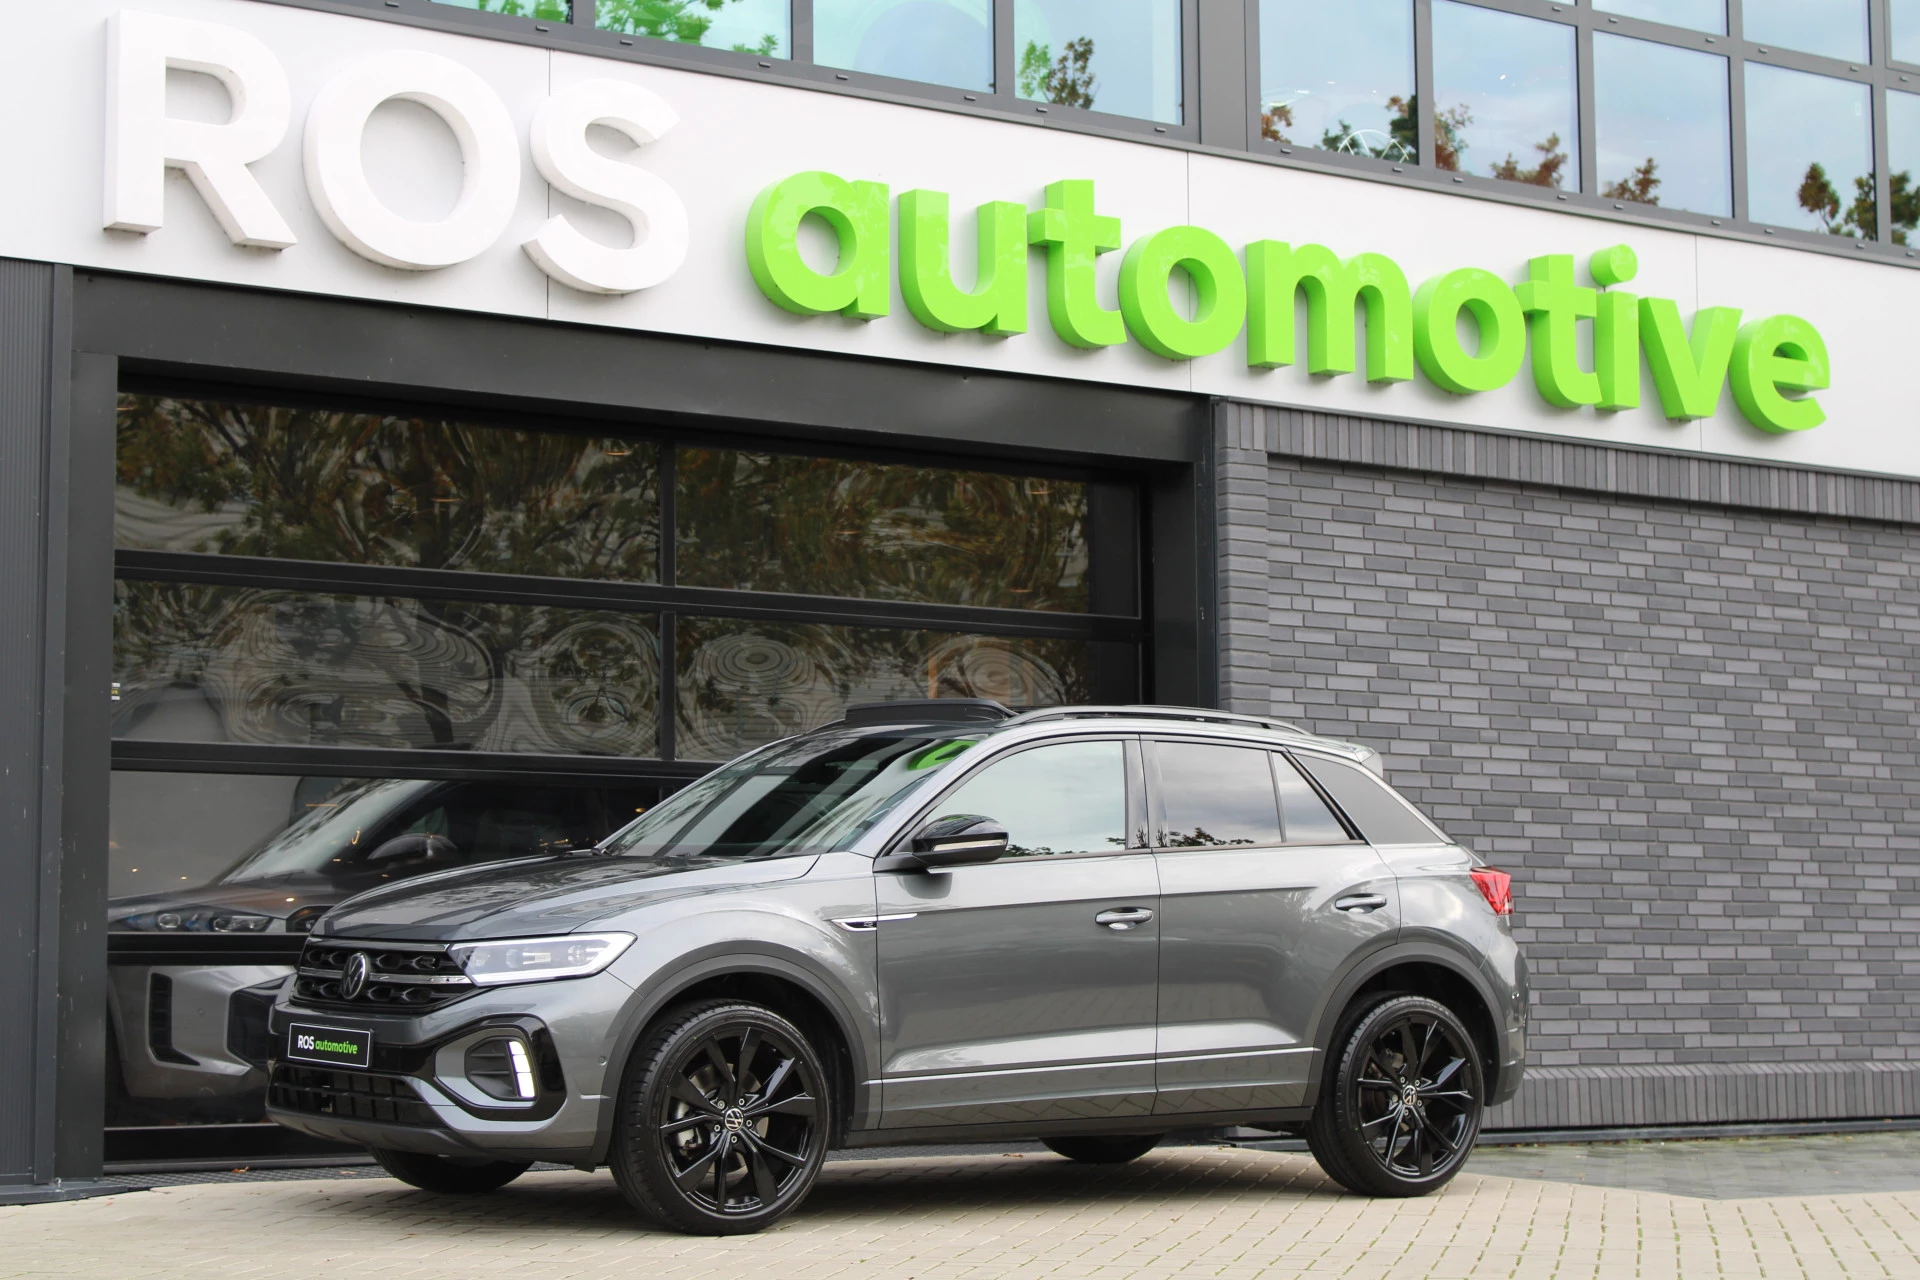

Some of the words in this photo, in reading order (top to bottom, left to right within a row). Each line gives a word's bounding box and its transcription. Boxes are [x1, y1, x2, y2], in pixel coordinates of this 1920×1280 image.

[103, 9, 690, 296] ROS
[744, 171, 1830, 435] automotive
[298, 1034, 315, 1050] ROS
[315, 1039, 358, 1054] automotive
